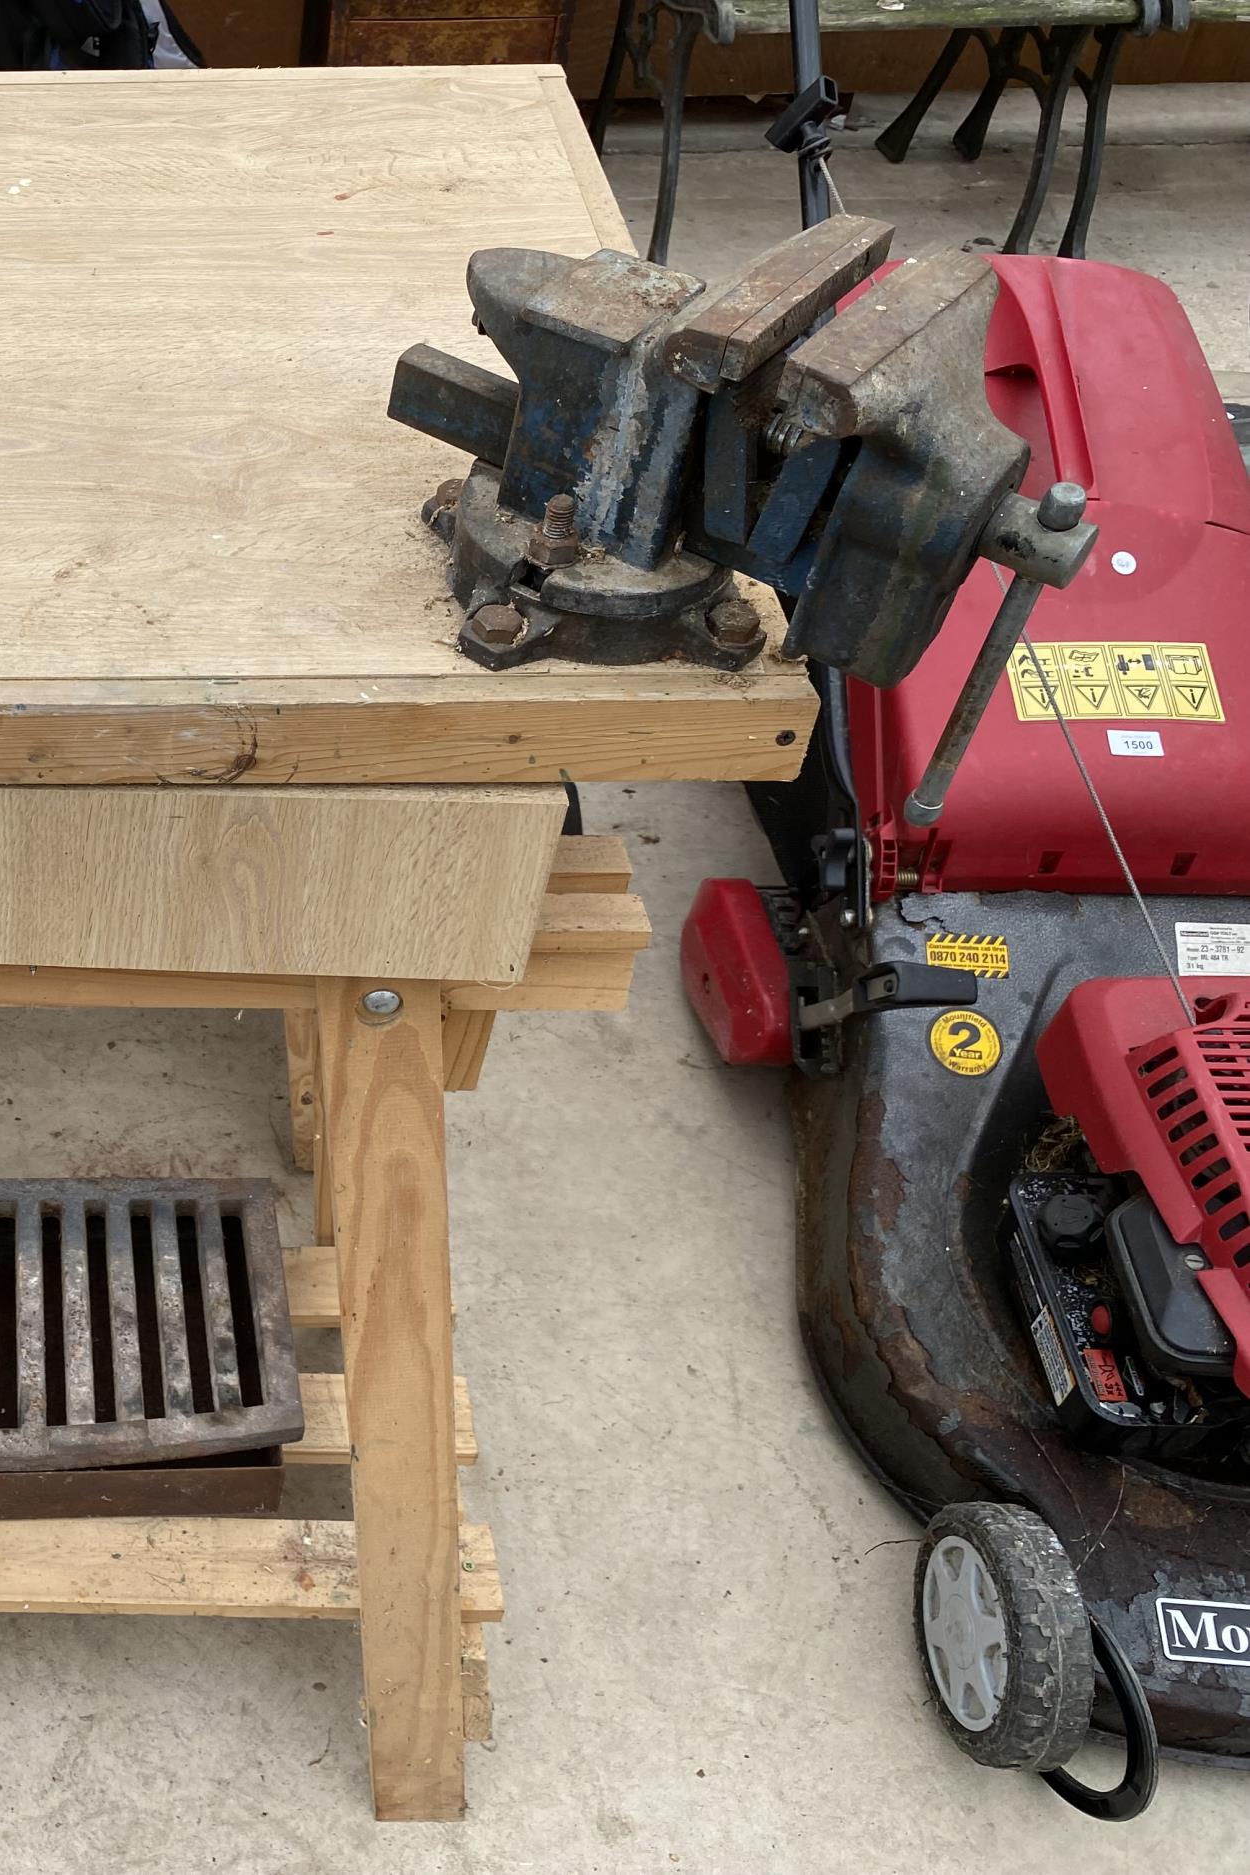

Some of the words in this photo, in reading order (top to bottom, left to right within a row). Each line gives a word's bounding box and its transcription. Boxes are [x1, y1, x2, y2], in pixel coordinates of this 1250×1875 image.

[1124, 740, 1153, 750] 1500
[929, 950, 957, 962] 0870
[958, 951, 979, 964] 240
[981, 952, 1006, 965] 2114
[941, 1013, 988, 1029] Mountfield
[949, 1021, 981, 1057] 2
[953, 1047, 981, 1058] Year
[949, 1059, 988, 1073] Warranty
[1165, 1609, 1250, 1654] Mo
